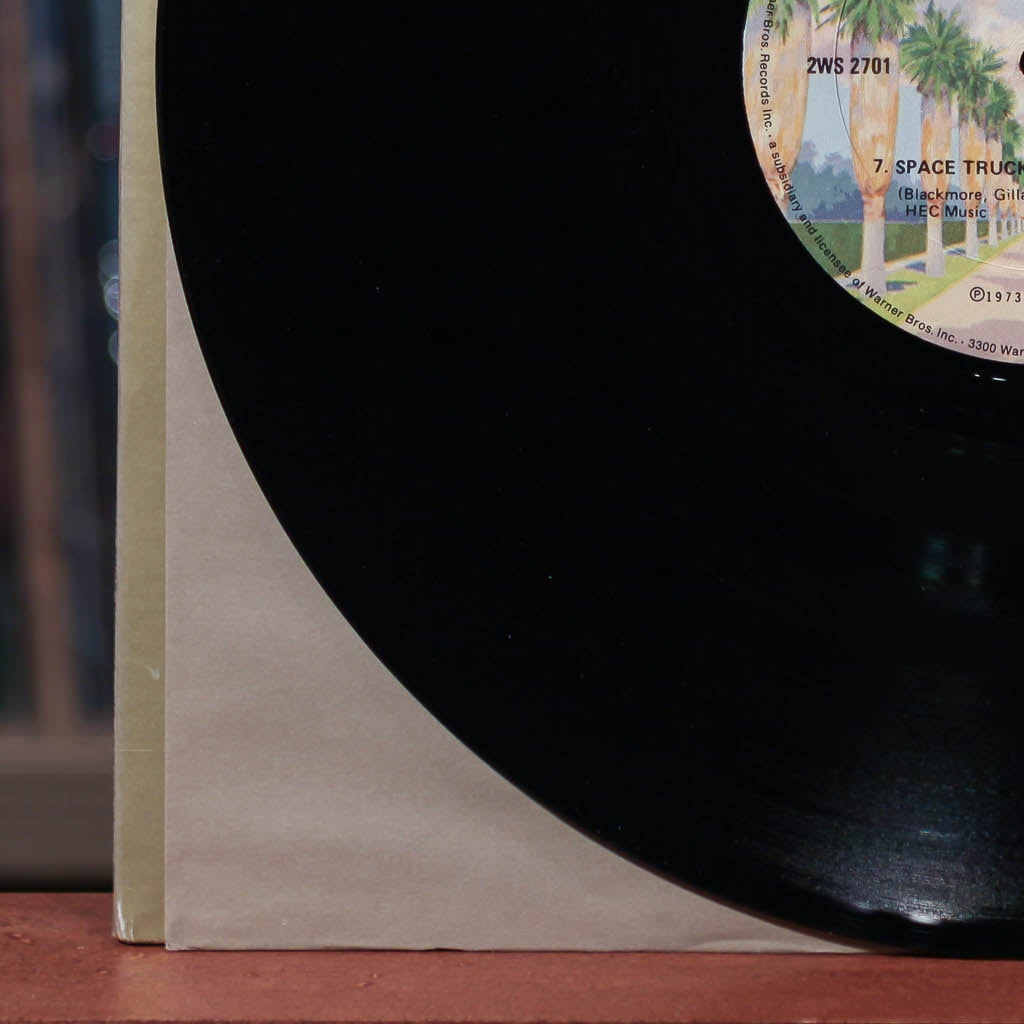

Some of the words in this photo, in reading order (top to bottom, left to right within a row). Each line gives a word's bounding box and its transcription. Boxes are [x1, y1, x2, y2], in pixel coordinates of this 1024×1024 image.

[760, 19, 774, 52] Bros.
[807, 56, 844, 75] 2WS
[850, 56, 891, 75] 2701
[759, 54, 771, 105] Records
[762, 109, 773, 132] Inc.
[872, 159, 889, 174] 7.
[895, 159, 956, 175] SPACE
[771, 152, 803, 212] subsidiary
[898, 187, 988, 203] (Blackmore,
[905, 205, 941, 218] HEC
[944, 205, 988, 219] Music
[798, 213, 818, 235] and
[815, 233, 852, 279] licensee
[852, 277, 865, 290] of
[863, 285, 904, 318] Warner
[904, 313, 934, 336] Bros.
[936, 327, 959, 345] Inc.
[968, 339, 997, 354] 3300
